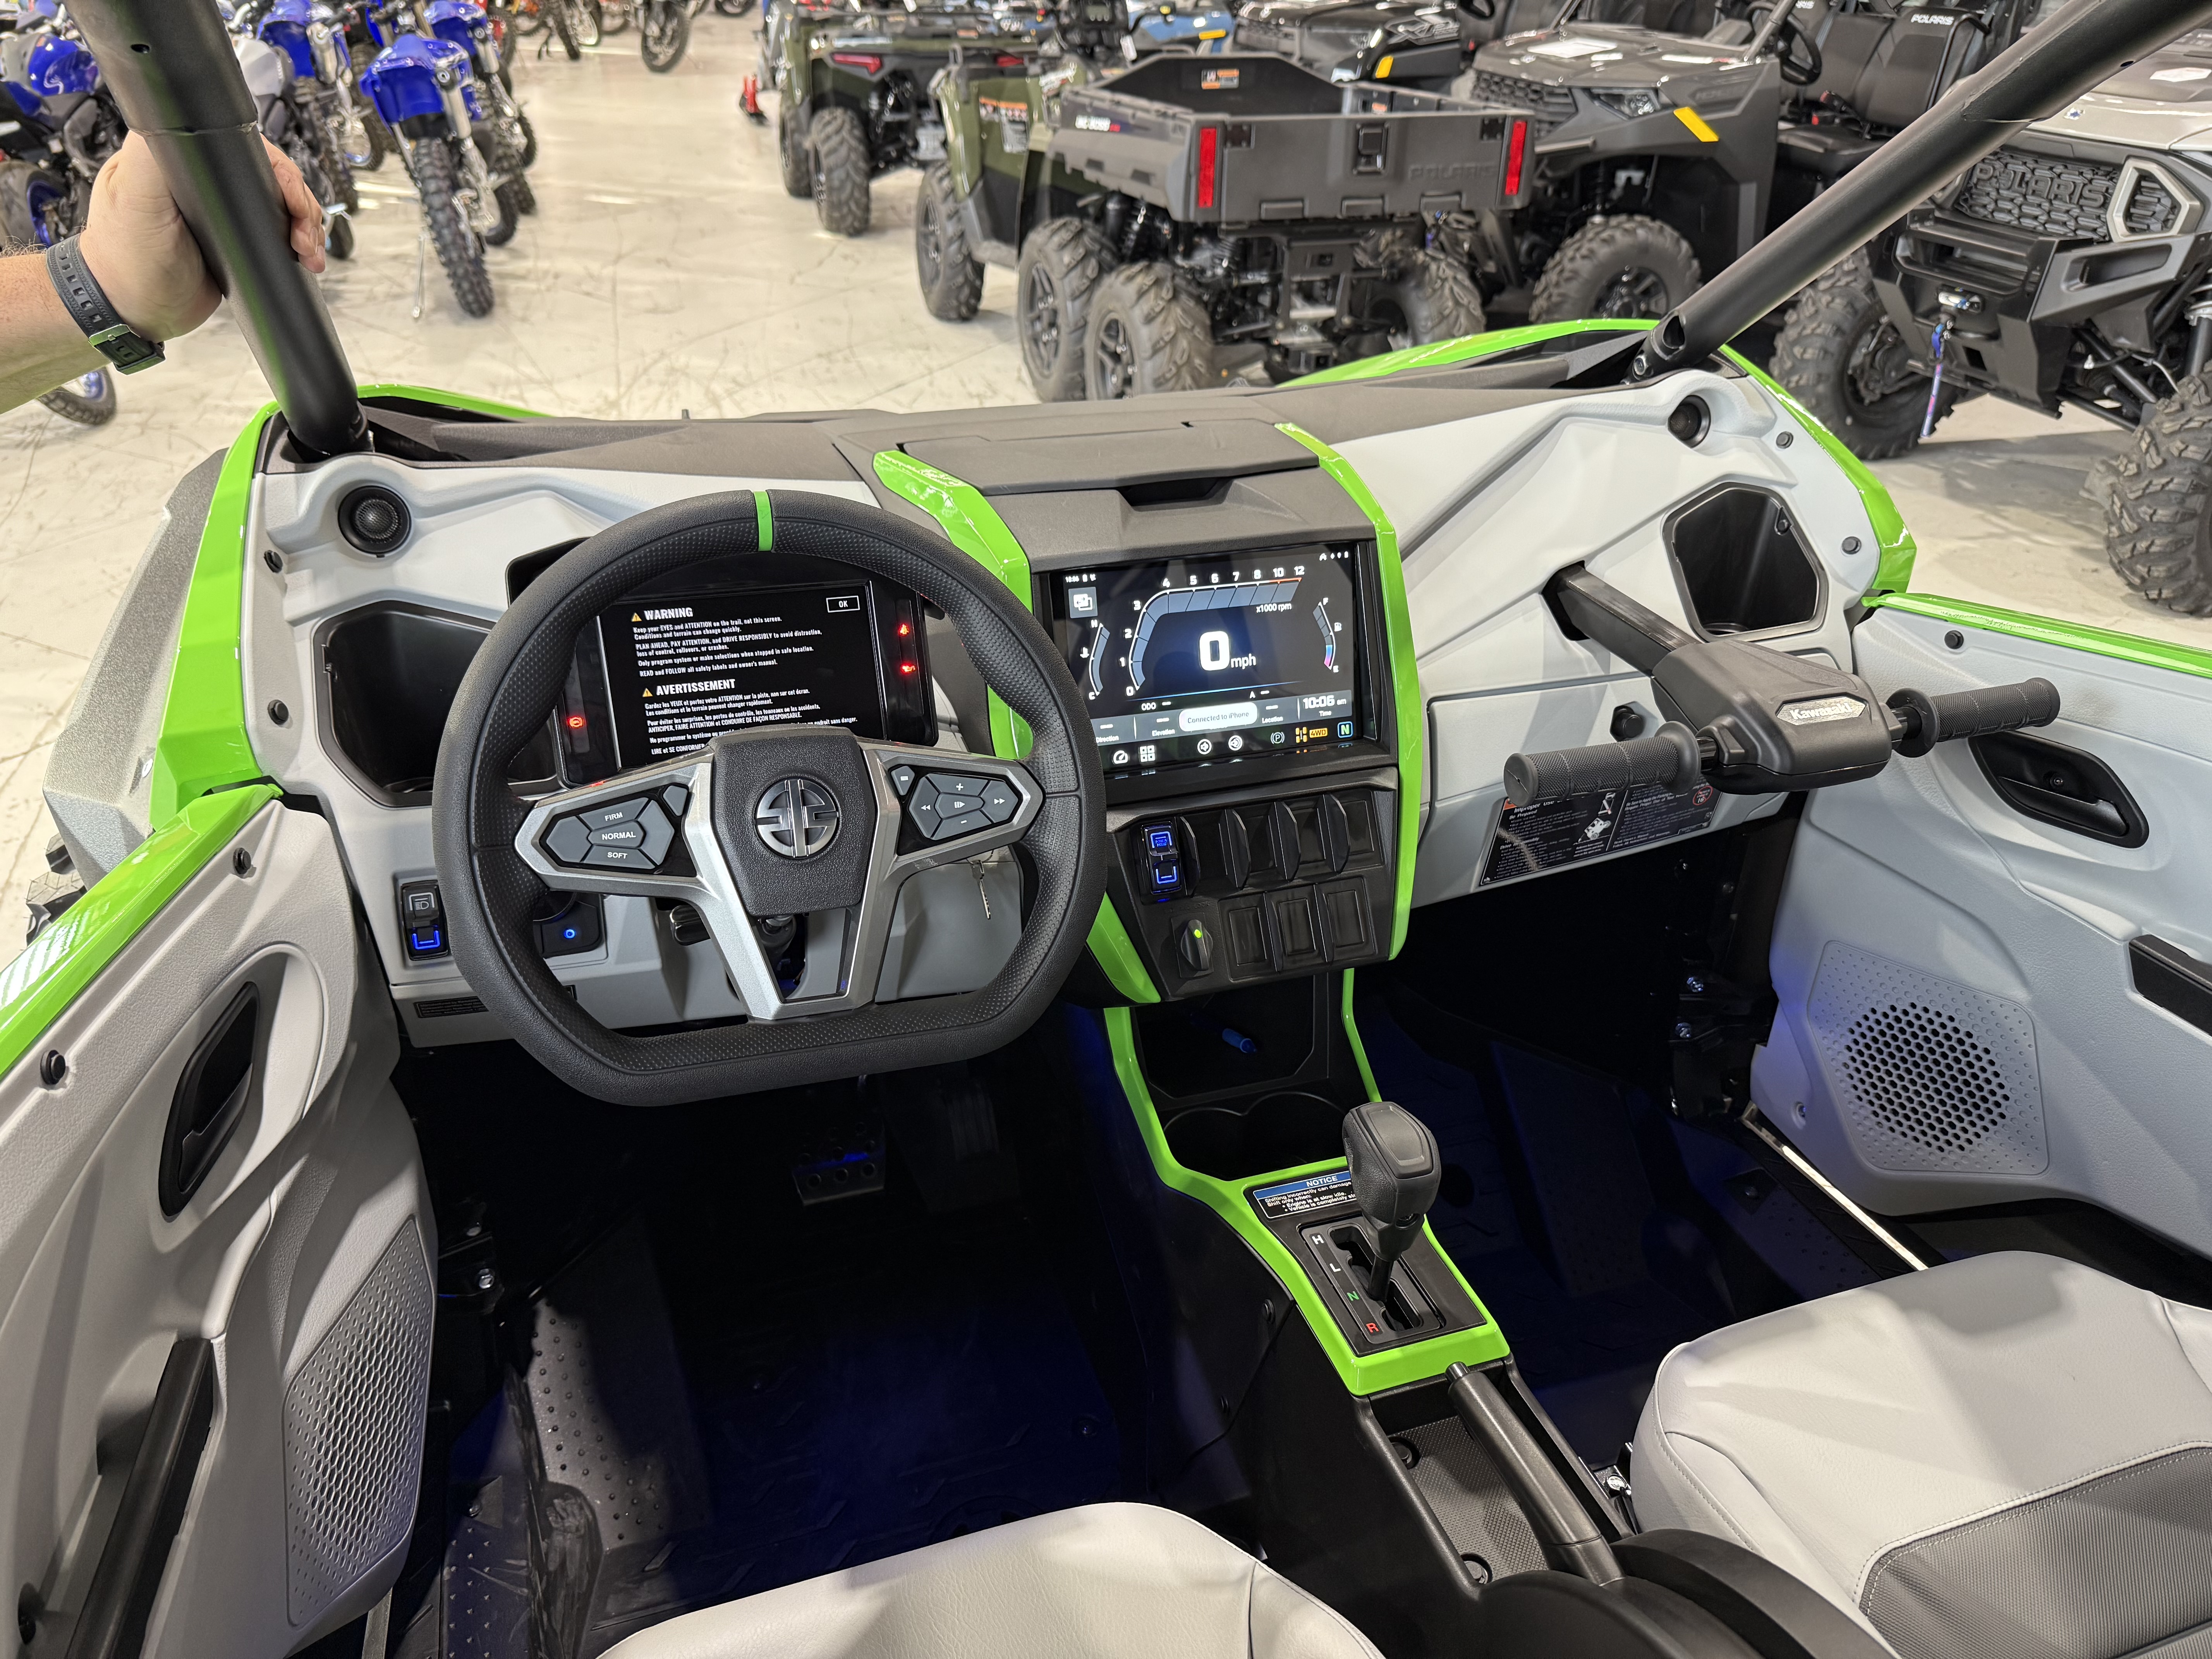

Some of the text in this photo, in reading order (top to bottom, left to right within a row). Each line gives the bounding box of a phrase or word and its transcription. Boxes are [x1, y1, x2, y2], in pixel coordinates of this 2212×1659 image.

[1911, 14, 1954, 25] POLARIS
[1971, 163, 2107, 208] POLARIS
[1163, 566, 1304, 587] 4 5 6 7 8 10 12
[1133, 601, 1141, 610] 3
[1255, 601, 1291, 613] x1000 rpm
[644, 608, 693, 620] WARNING
[685, 622, 712, 630] ATTENTION
[1091, 620, 1097, 628] H
[738, 633, 772, 641] RESPONSIBLY
[1125, 629, 1132, 638] 2
[1200, 631, 1256, 670] 0 mph
[1120, 657, 1125, 666] 1
[656, 679, 735, 696] AVERTISSEMENT
[1126, 687, 1133, 696] 0
[1142, 702, 1156, 711] ODO
[1303, 695, 1335, 709] 10:06
[1789, 702, 1852, 720] Kawasaki
[690, 720, 714, 728] ATTENTION
[769, 712, 802, 720] RESPONSABLE.
[1188, 713, 1219, 723] Connected
[1229, 711, 1249, 719] iPhone
[1341, 725, 1349, 735] N
[1514, 803, 1541, 813] Improper
[605, 812, 623, 821] FIRM
[602, 831, 636, 840] NORMAL
[1306, 1175, 1338, 1187] NOTICE
[1288, 1189, 1316, 1198] incorrectly
[1317, 1196, 1347, 1206] completely
[1312, 1235, 1324, 1245] H
[1329, 1263, 1341, 1272] L
[1347, 1291, 1360, 1301] N
[1366, 1322, 1379, 1333] R
